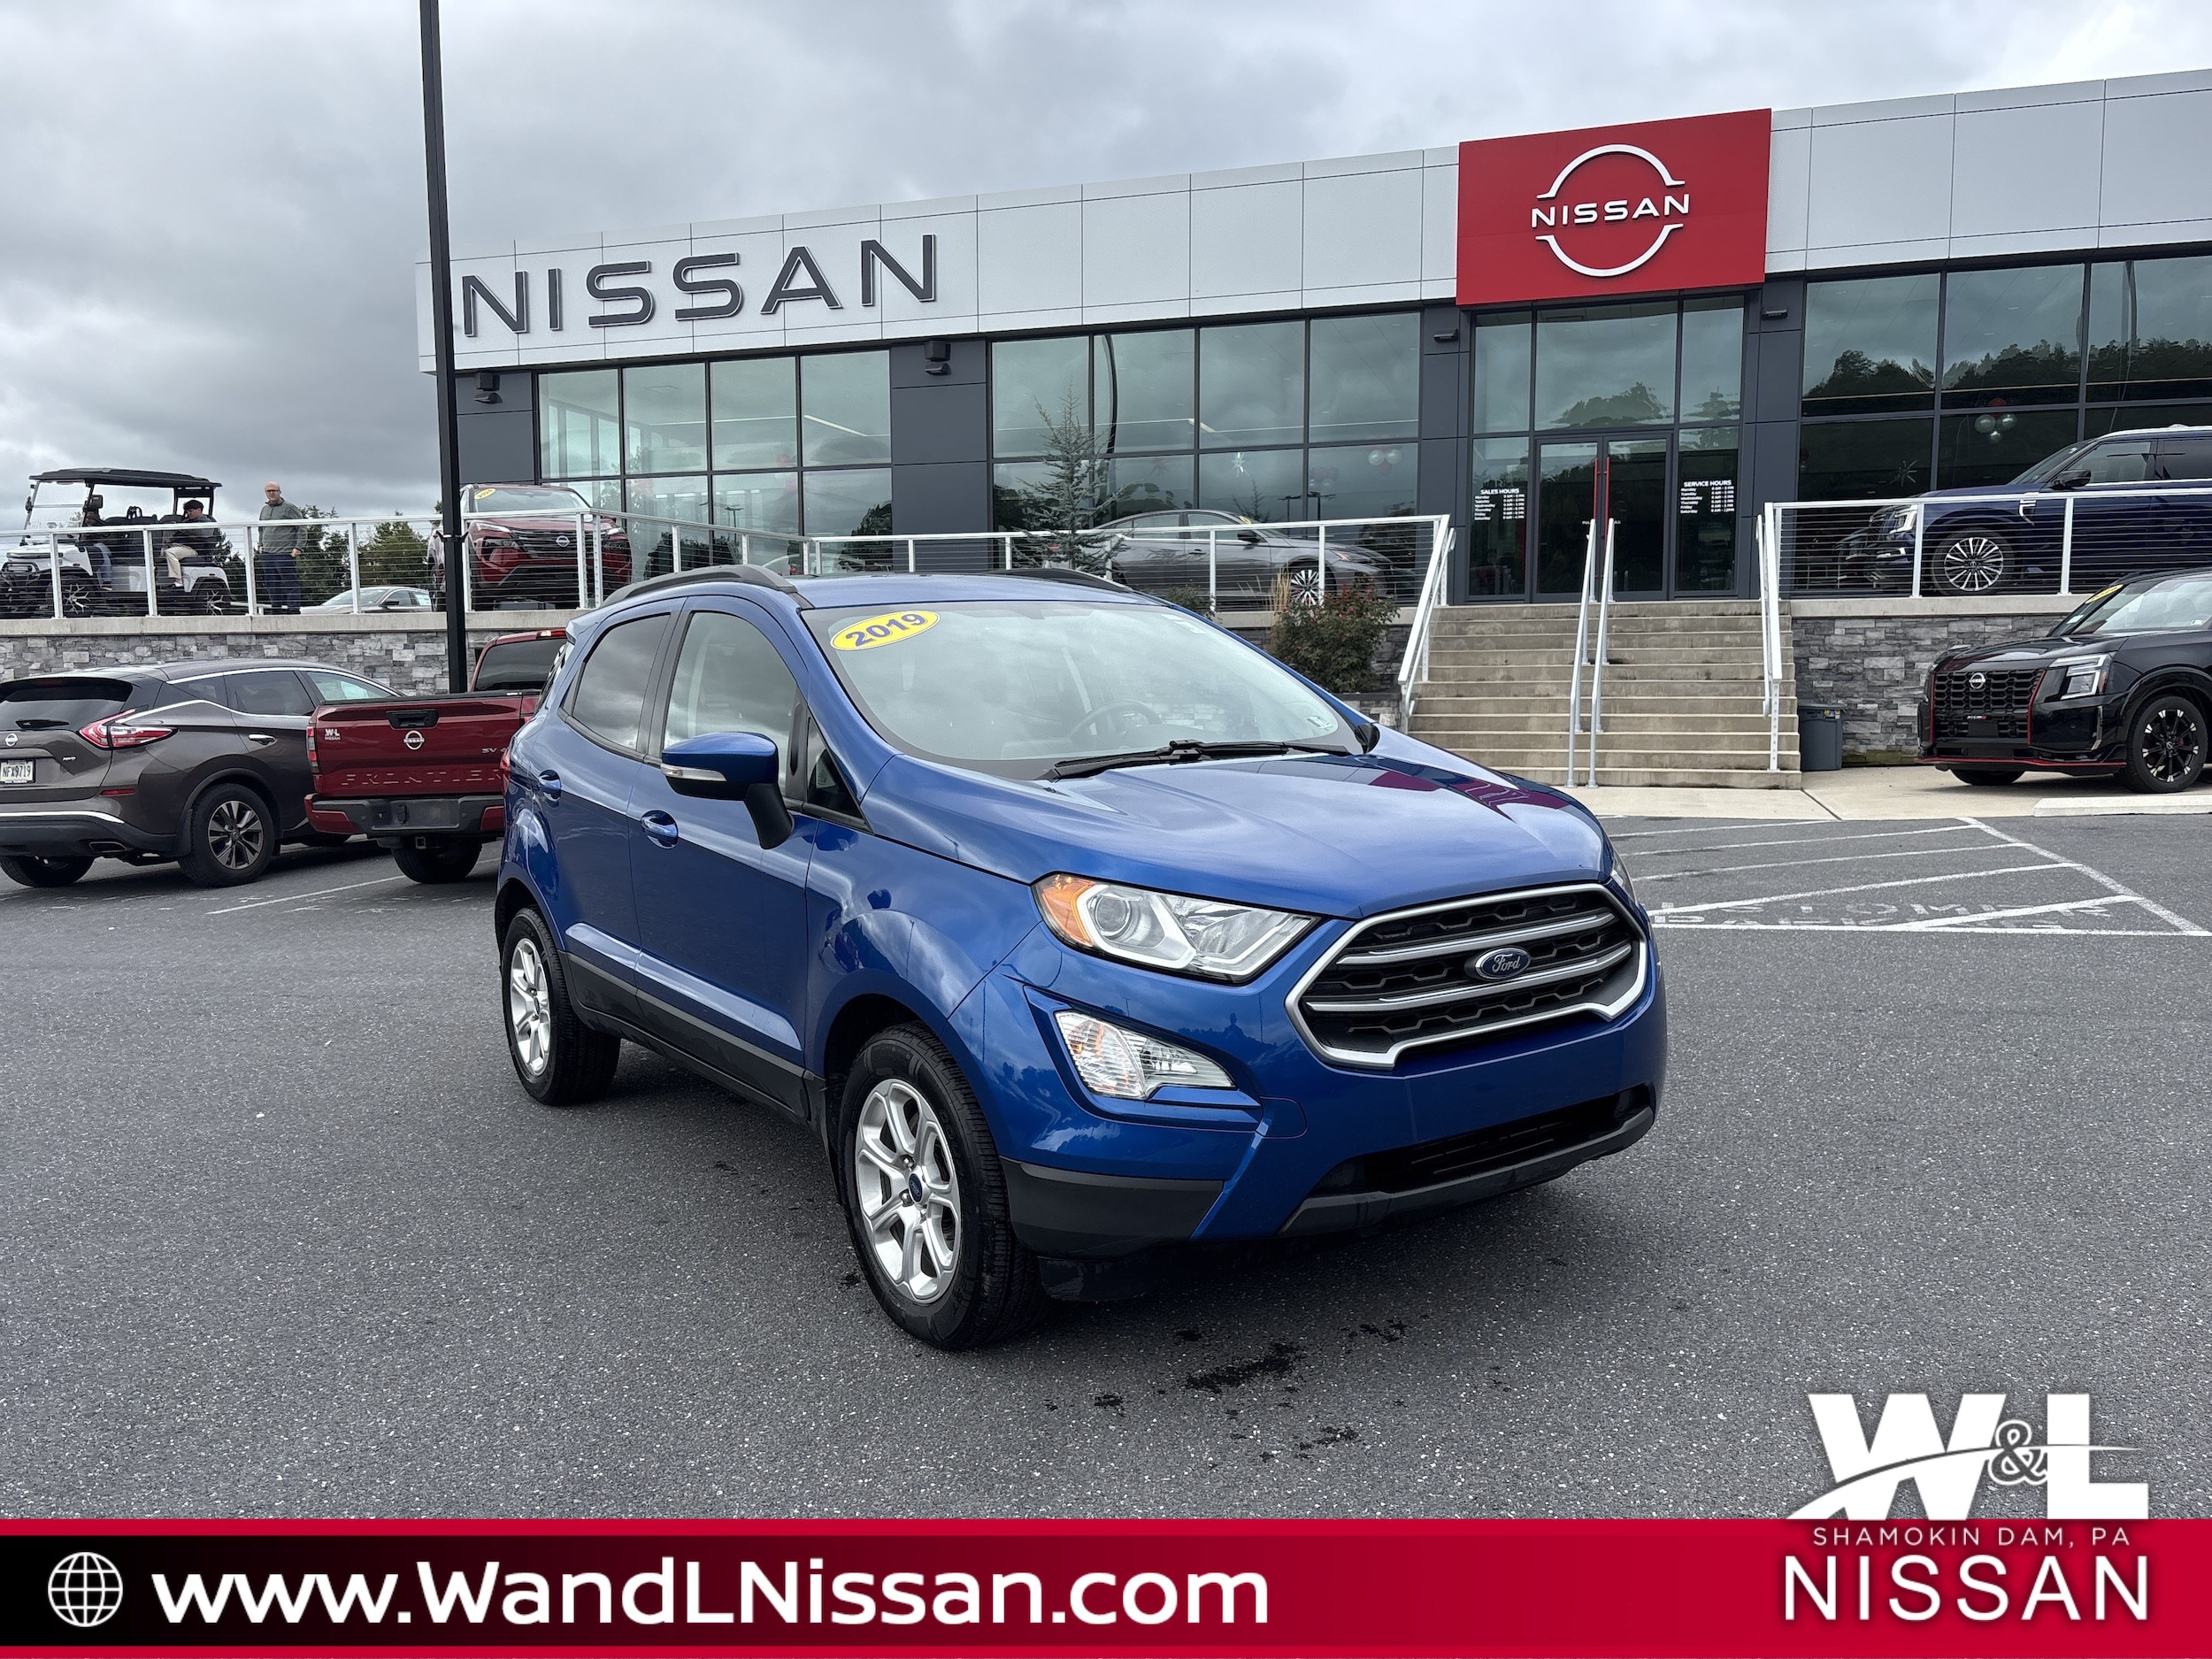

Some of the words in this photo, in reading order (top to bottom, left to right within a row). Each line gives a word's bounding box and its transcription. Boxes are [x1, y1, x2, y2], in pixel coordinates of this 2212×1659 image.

[1531, 193, 1690, 228] NISSAN
[462, 234, 936, 337] NISSAN
[845, 613, 927, 648] 2019
[1492, 953, 1521, 973] Ford
